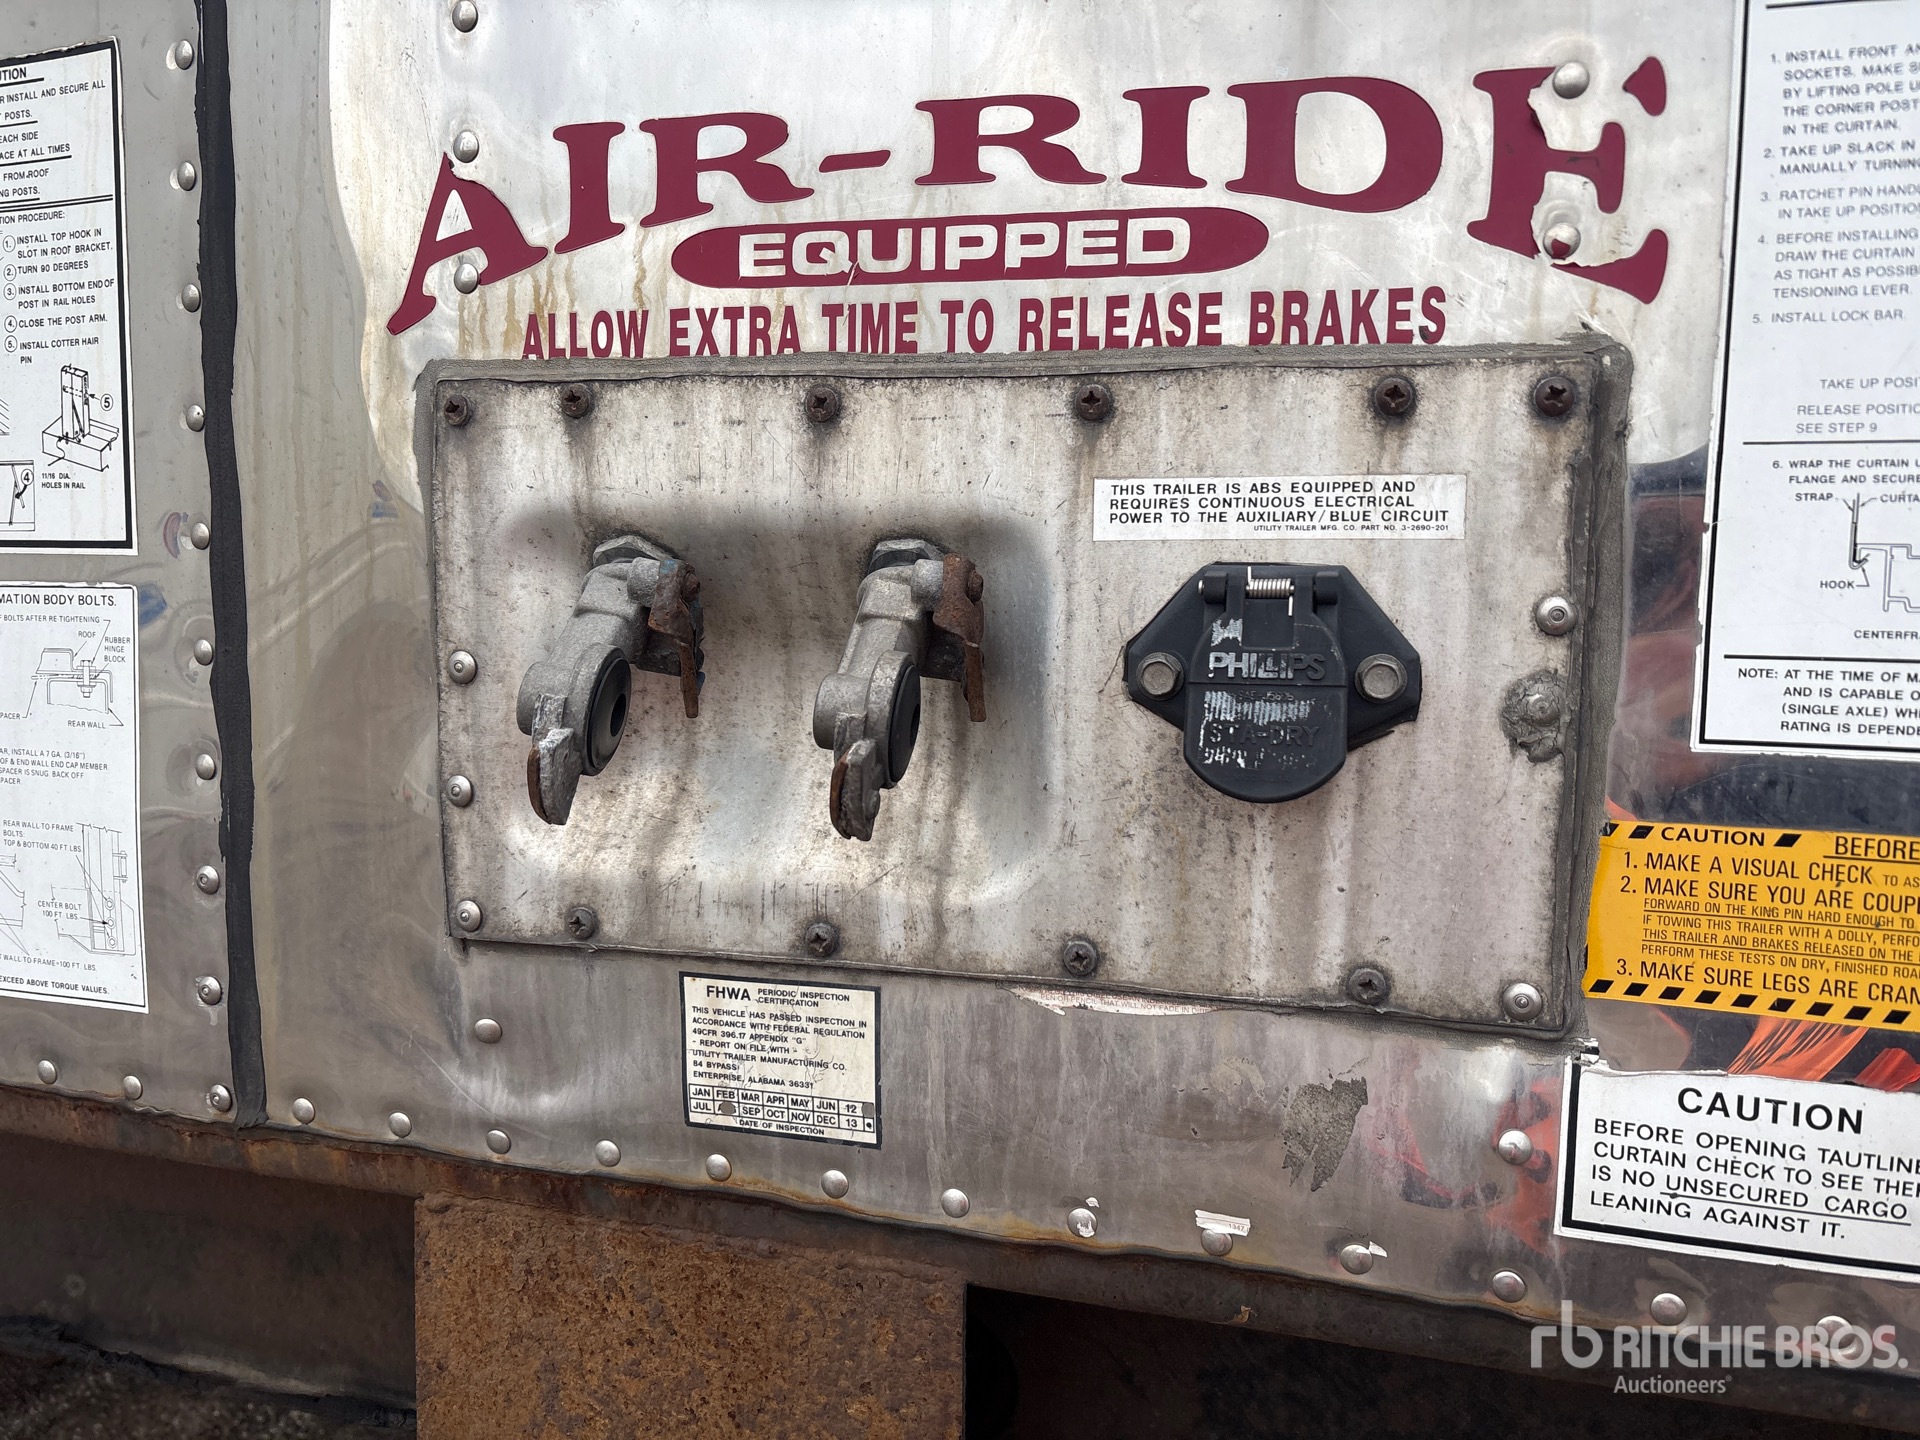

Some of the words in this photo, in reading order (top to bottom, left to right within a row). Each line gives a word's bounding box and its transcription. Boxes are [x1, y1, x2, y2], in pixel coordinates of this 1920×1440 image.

[1786, 49, 1841, 62] INSTALL
[1849, 45, 1897, 58] FRONT
[7, 92, 38, 102] INSTALL
[41, 88, 56, 97] AND
[59, 84, 89, 95] SECURE
[92, 80, 105, 90] ALL
[386, 56, 1668, 335] AIR-RIDE
[17, 234, 48, 245] INSTALL
[51, 232, 66, 241] TOP
[70, 230, 92, 238] HOOK
[94, 229, 102, 237] IN
[18, 248, 37, 258] SLOT
[40, 247, 48, 257] IN
[51, 246, 71, 255] ROOF
[75, 242, 113, 253] BRACKET.
[739, 216, 1191, 277] EQUIPPED
[522, 310, 649, 360] ALLOW
[669, 306, 799, 357] EXTRA
[822, 301, 918, 355] TIME
[940, 299, 994, 352] TO
[1018, 290, 1223, 352] RELEASE
[1249, 286, 1447, 346] BRAKES
[1771, 312, 1826, 323] INSTALL
[1831, 310, 1869, 322] LOCK
[1796, 423, 1822, 433] SEE
[1828, 423, 1864, 432] STEP
[1870, 423, 1877, 432] 9
[1773, 460, 1783, 468] 6.
[1789, 460, 1823, 468] WRAP
[1828, 460, 1850, 468] THE
[1857, 459, 1909, 468] CURTAIN
[1111, 485, 1145, 495] THIS
[1153, 484, 1217, 495] TRAILER
[1226, 483, 1240, 494] IS
[1250, 482, 1281, 493] ABS
[1291, 482, 1373, 493] EQUIPPED
[1382, 481, 1415, 492] AND
[1110, 498, 1189, 509] REQUIRES
[1199, 497, 1305, 509] CONTINUOUS
[1314, 495, 1414, 508] ELECTRICAL
[1795, 493, 1833, 501] STRAP
[1110, 512, 1162, 524] POWER
[1171, 512, 1189, 523] TO
[1198, 512, 1227, 522] THE
[1381, 510, 1449, 522] CIRCUIT
[1820, 581, 1854, 589] HOOK
[44, 595, 74, 606] BODY
[78, 595, 116, 606] BOLTS.
[105, 636, 130, 644] RUBBER
[104, 645, 124, 653] HINGE
[104, 655, 125, 663] BLOCK
[1209, 652, 1326, 680] PHILLIPS
[1739, 668, 1778, 678] NOTE:
[1785, 670, 1800, 679] AT
[1807, 670, 1833, 680] THE
[1840, 671, 1873, 681] TIME
[1881, 672, 1900, 681] OF
[1661, 827, 1765, 846] CAUTION
[1836, 836, 1920, 860] BEFORE
[1624, 852, 1638, 869] 1.
[1646, 853, 1700, 872] MAKE
[1709, 857, 1722, 873] A
[1732, 858, 1799, 878] VISUAL
[1809, 863, 1872, 884] CHECK
[1884, 875, 1897, 886] TO
[1620, 876, 1636, 893] 2.
[1645, 878, 1698, 896] MAKE
[1709, 882, 1757, 901] SURE
[1767, 886, 1805, 904] YOU
[1814, 890, 1852, 908] ARE
[1644, 898, 1700, 912] FORWARD
[1705, 903, 1719, 913] ON
[1726, 904, 1746, 915] THE
[1752, 906, 1778, 918] KING
[1784, 908, 1802, 920] PIN
[1808, 910, 1840, 922] HARD
[1846, 913, 1893, 927] ENOUGH
[1901, 918, 1914, 928] TO
[27, 979, 48, 987] ABOVE
[51, 982, 79, 991] TORQUE
[82, 985, 109, 994] VALUES.
[1617, 959, 1632, 976] 3.
[1641, 961, 1694, 981] MAKE
[1704, 967, 1753, 987] SURE
[1763, 972, 1809, 993] LEGS
[1819, 978, 1860, 999] ARE
[706, 985, 750, 1001] FHWA
[758, 988, 796, 997] PERIODIC
[800, 992, 850, 1001] INSPECTION
[758, 998, 818, 1007] CERTIFICATION
[692, 1006, 709, 1014] THIS
[712, 1008, 745, 1017] VEHICLE
[749, 1011, 765, 1019] HAS
[770, 1013, 801, 1022] PASSED
[805, 1017, 855, 1027] INSPECTION
[693, 1088, 710, 1097] JAN
[716, 1091, 735, 1099] FEB
[741, 1093, 760, 1101] MAR
[766, 1096, 785, 1104] APR
[791, 1098, 809, 1107] MAY
[816, 1102, 836, 1111] JUN
[845, 1105, 857, 1113] 12
[693, 1102, 711, 1111] JUL
[743, 1106, 760, 1116] SEP
[767, 1110, 785, 1119] OCT
[791, 1113, 810, 1122] NOV
[816, 1115, 836, 1125] DEC
[846, 1119, 857, 1127] 13
[1678, 1088, 1863, 1135] CAUTION
[776, 1124, 824, 1135] INSPECTION
[1595, 1118, 1683, 1145] BEFORE
[1696, 1133, 1805, 1160] OPENING
[1594, 1141, 1686, 1168] CURTAIN
[1697, 1156, 1775, 1180] CHECK
[1784, 1167, 1812, 1185] TO
[1821, 1172, 1863, 1191] SEE
[1593, 1164, 1611, 1181] IS
[1622, 1168, 1654, 1187] NO
[1666, 1175, 1808, 1207] UNSECURED
[1824, 1196, 1907, 1220] CARGO
[1591, 1190, 1691, 1218] LEANING
[1703, 1206, 1810, 1233] AGAINST
[1821, 1221, 1845, 1239] IT.
